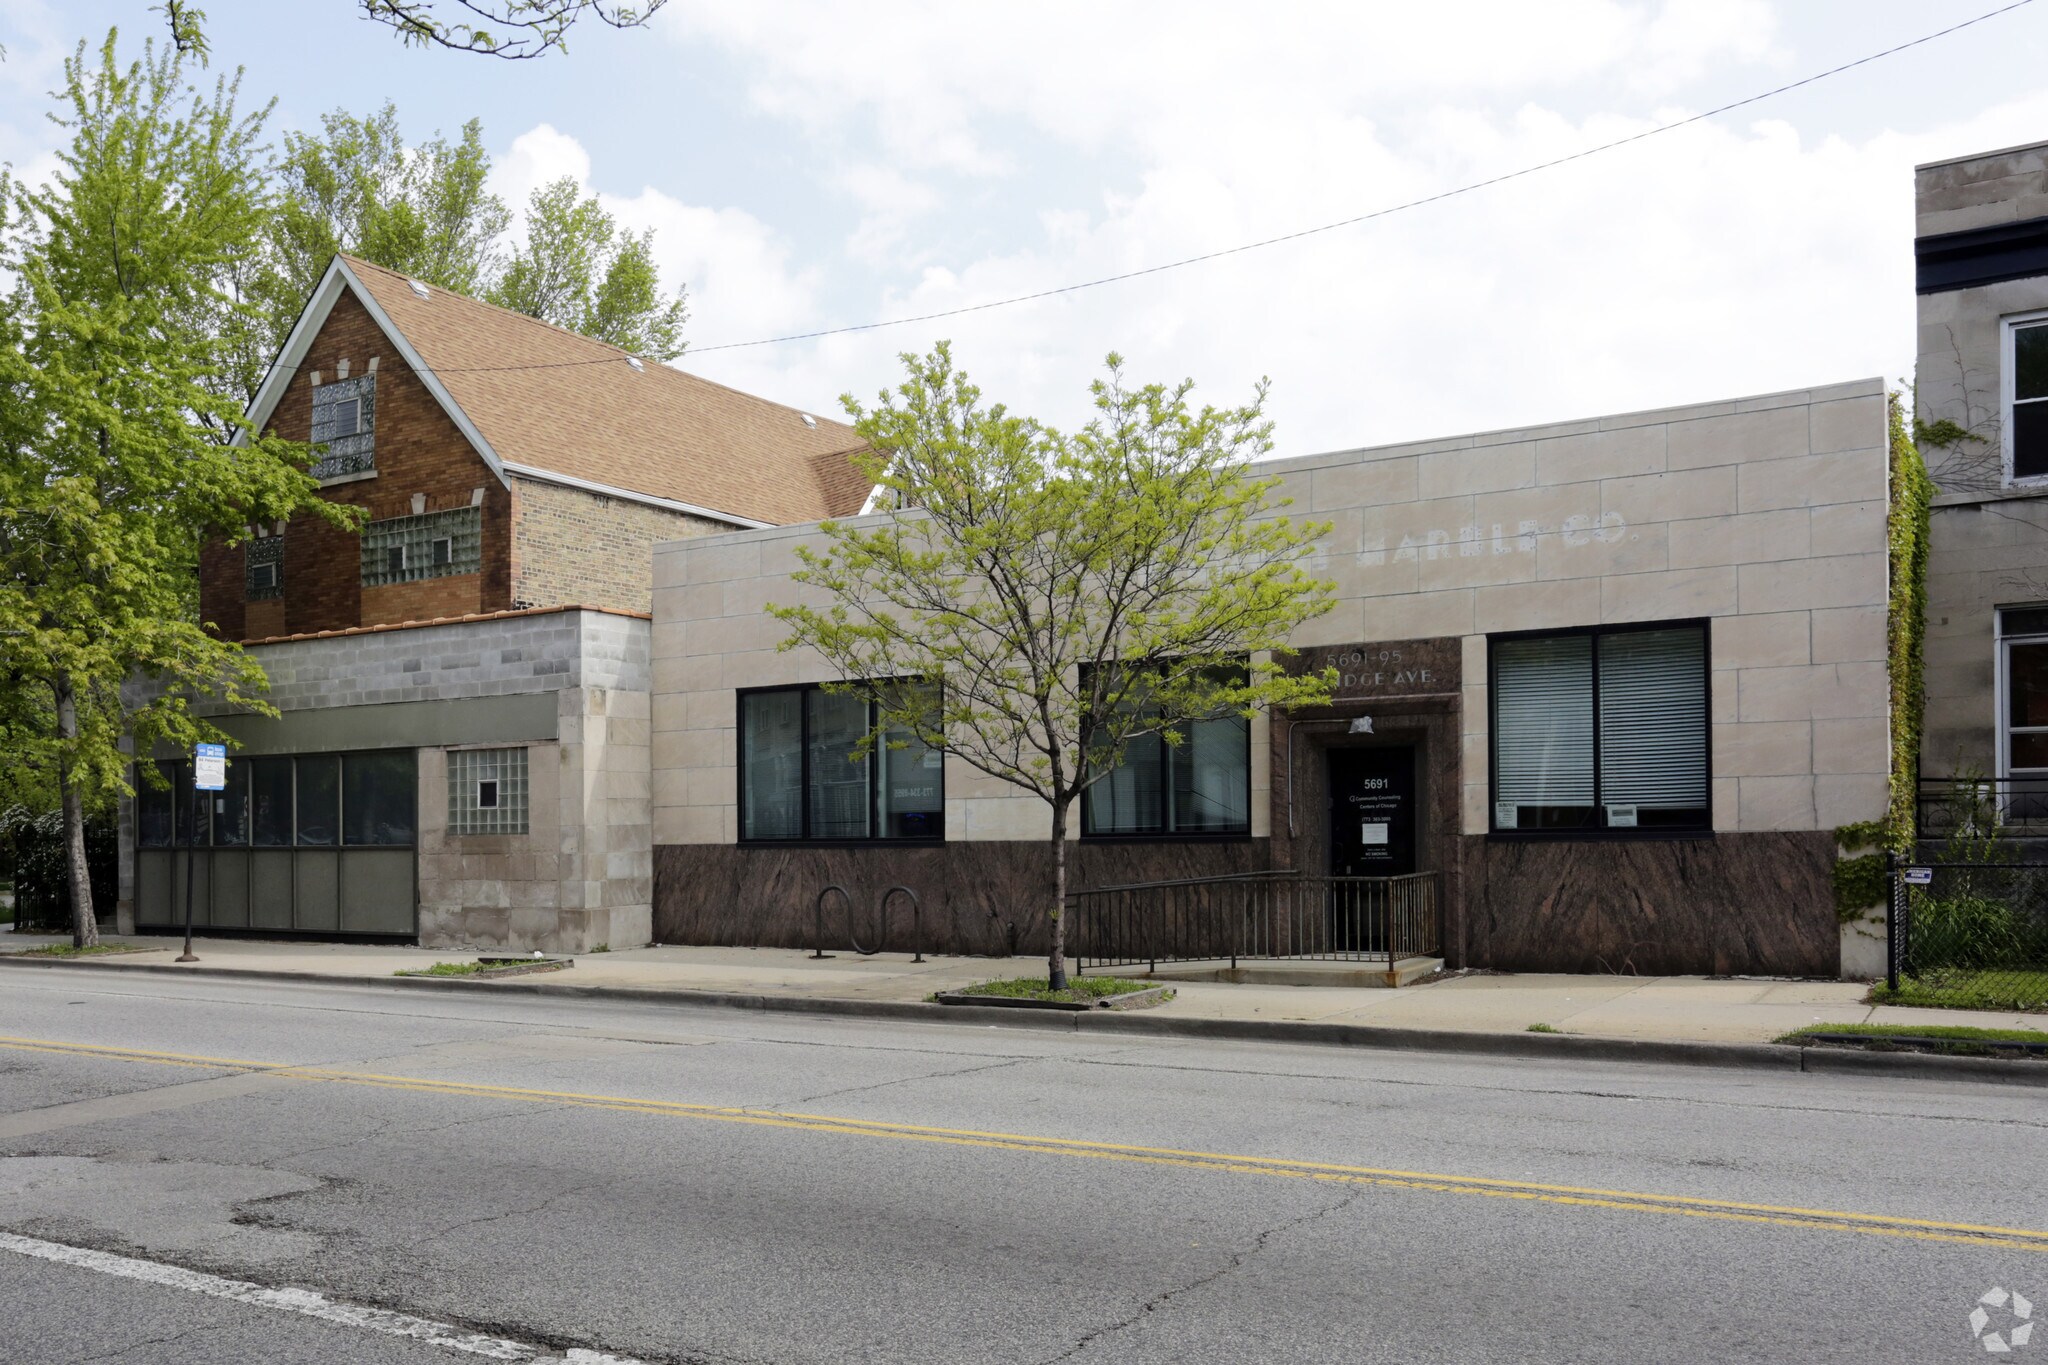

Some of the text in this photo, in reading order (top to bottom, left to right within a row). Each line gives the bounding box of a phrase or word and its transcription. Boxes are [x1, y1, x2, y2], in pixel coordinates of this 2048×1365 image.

[1327, 650, 1402, 668] 5691-95
[1323, 669, 1437, 688] IDGE AVE.
[1364, 778, 1388, 789] 5691
